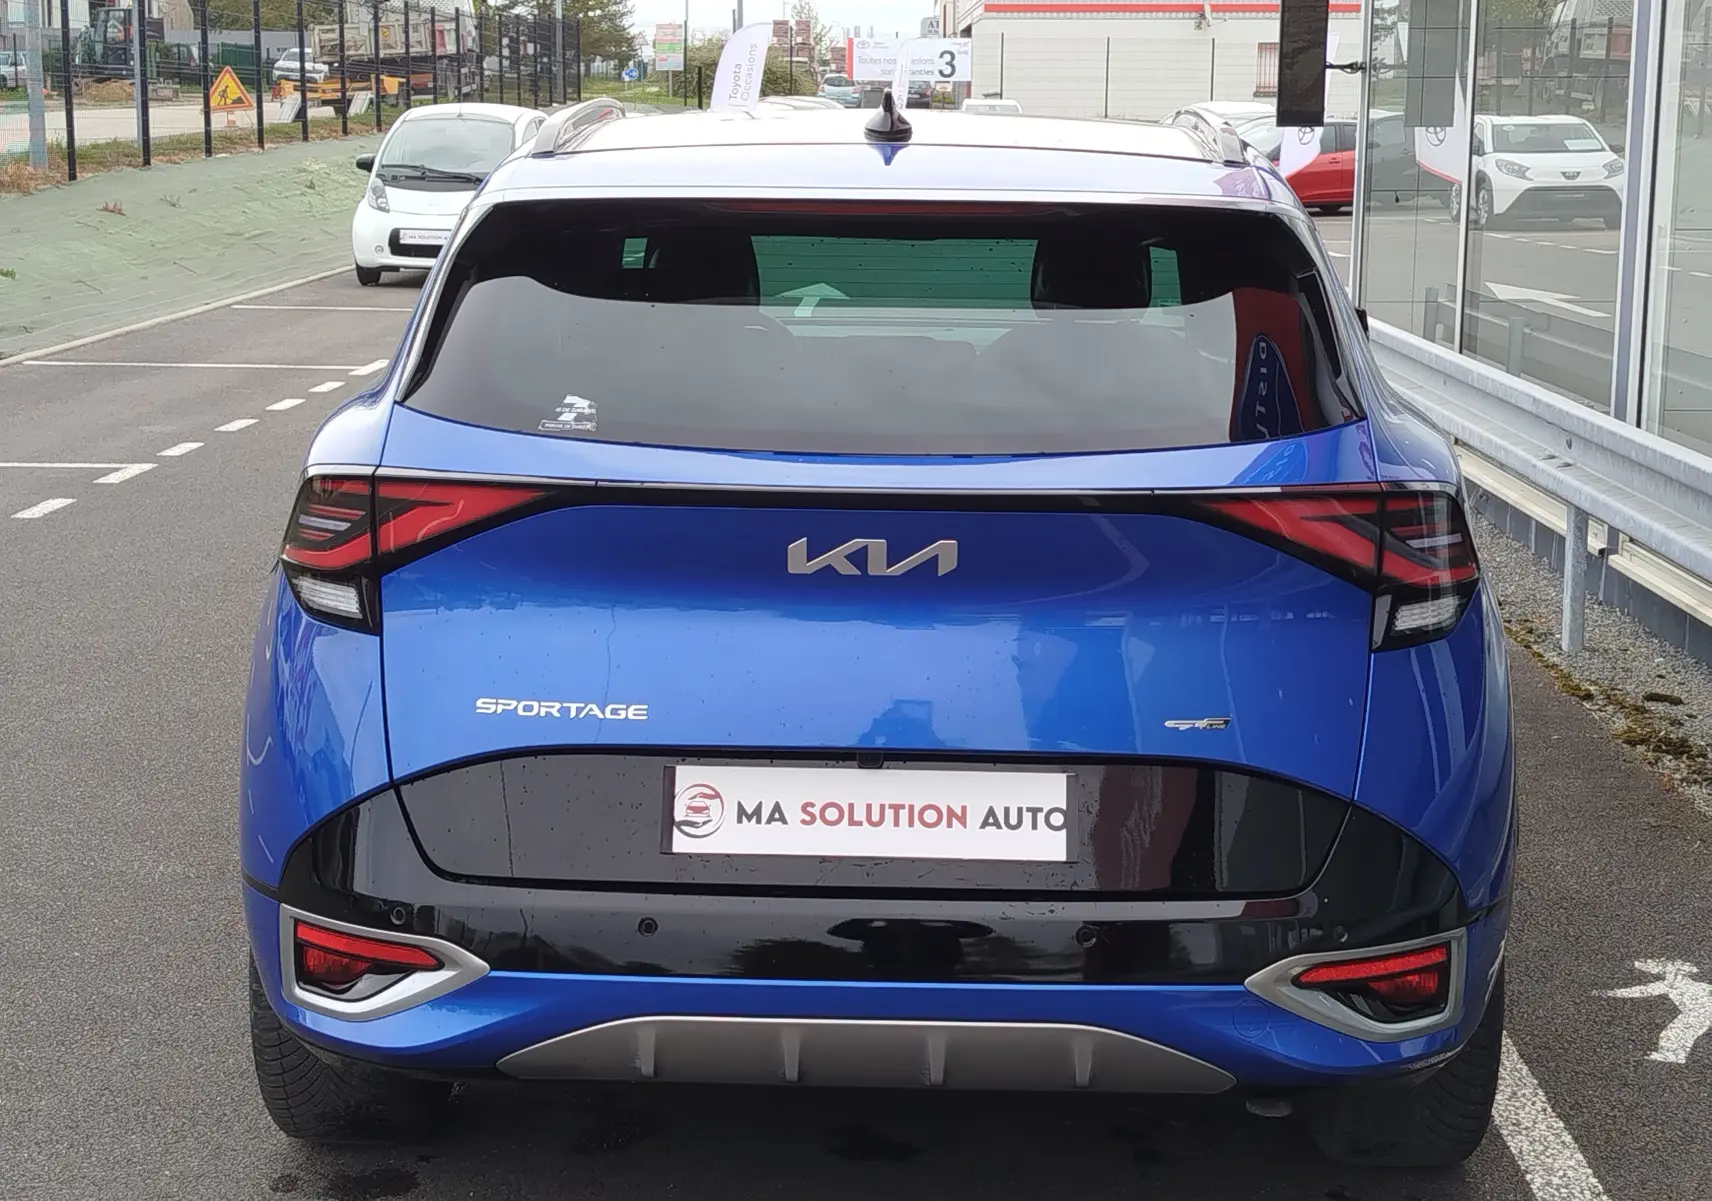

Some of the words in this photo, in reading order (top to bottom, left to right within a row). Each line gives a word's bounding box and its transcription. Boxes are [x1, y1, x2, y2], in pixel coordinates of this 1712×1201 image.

[740, 43, 758, 102] Occasions
[857, 56, 882, 65] Toutes
[883, 57, 897, 65] nos
[938, 50, 956, 78] 3
[728, 64, 742, 101] Toyota
[788, 537, 958, 577] KIA
[475, 697, 649, 720] SPORTAGE
[736, 800, 789, 826] MA
[799, 801, 968, 829] SOLUTION
[979, 805, 1067, 832] AUTO
